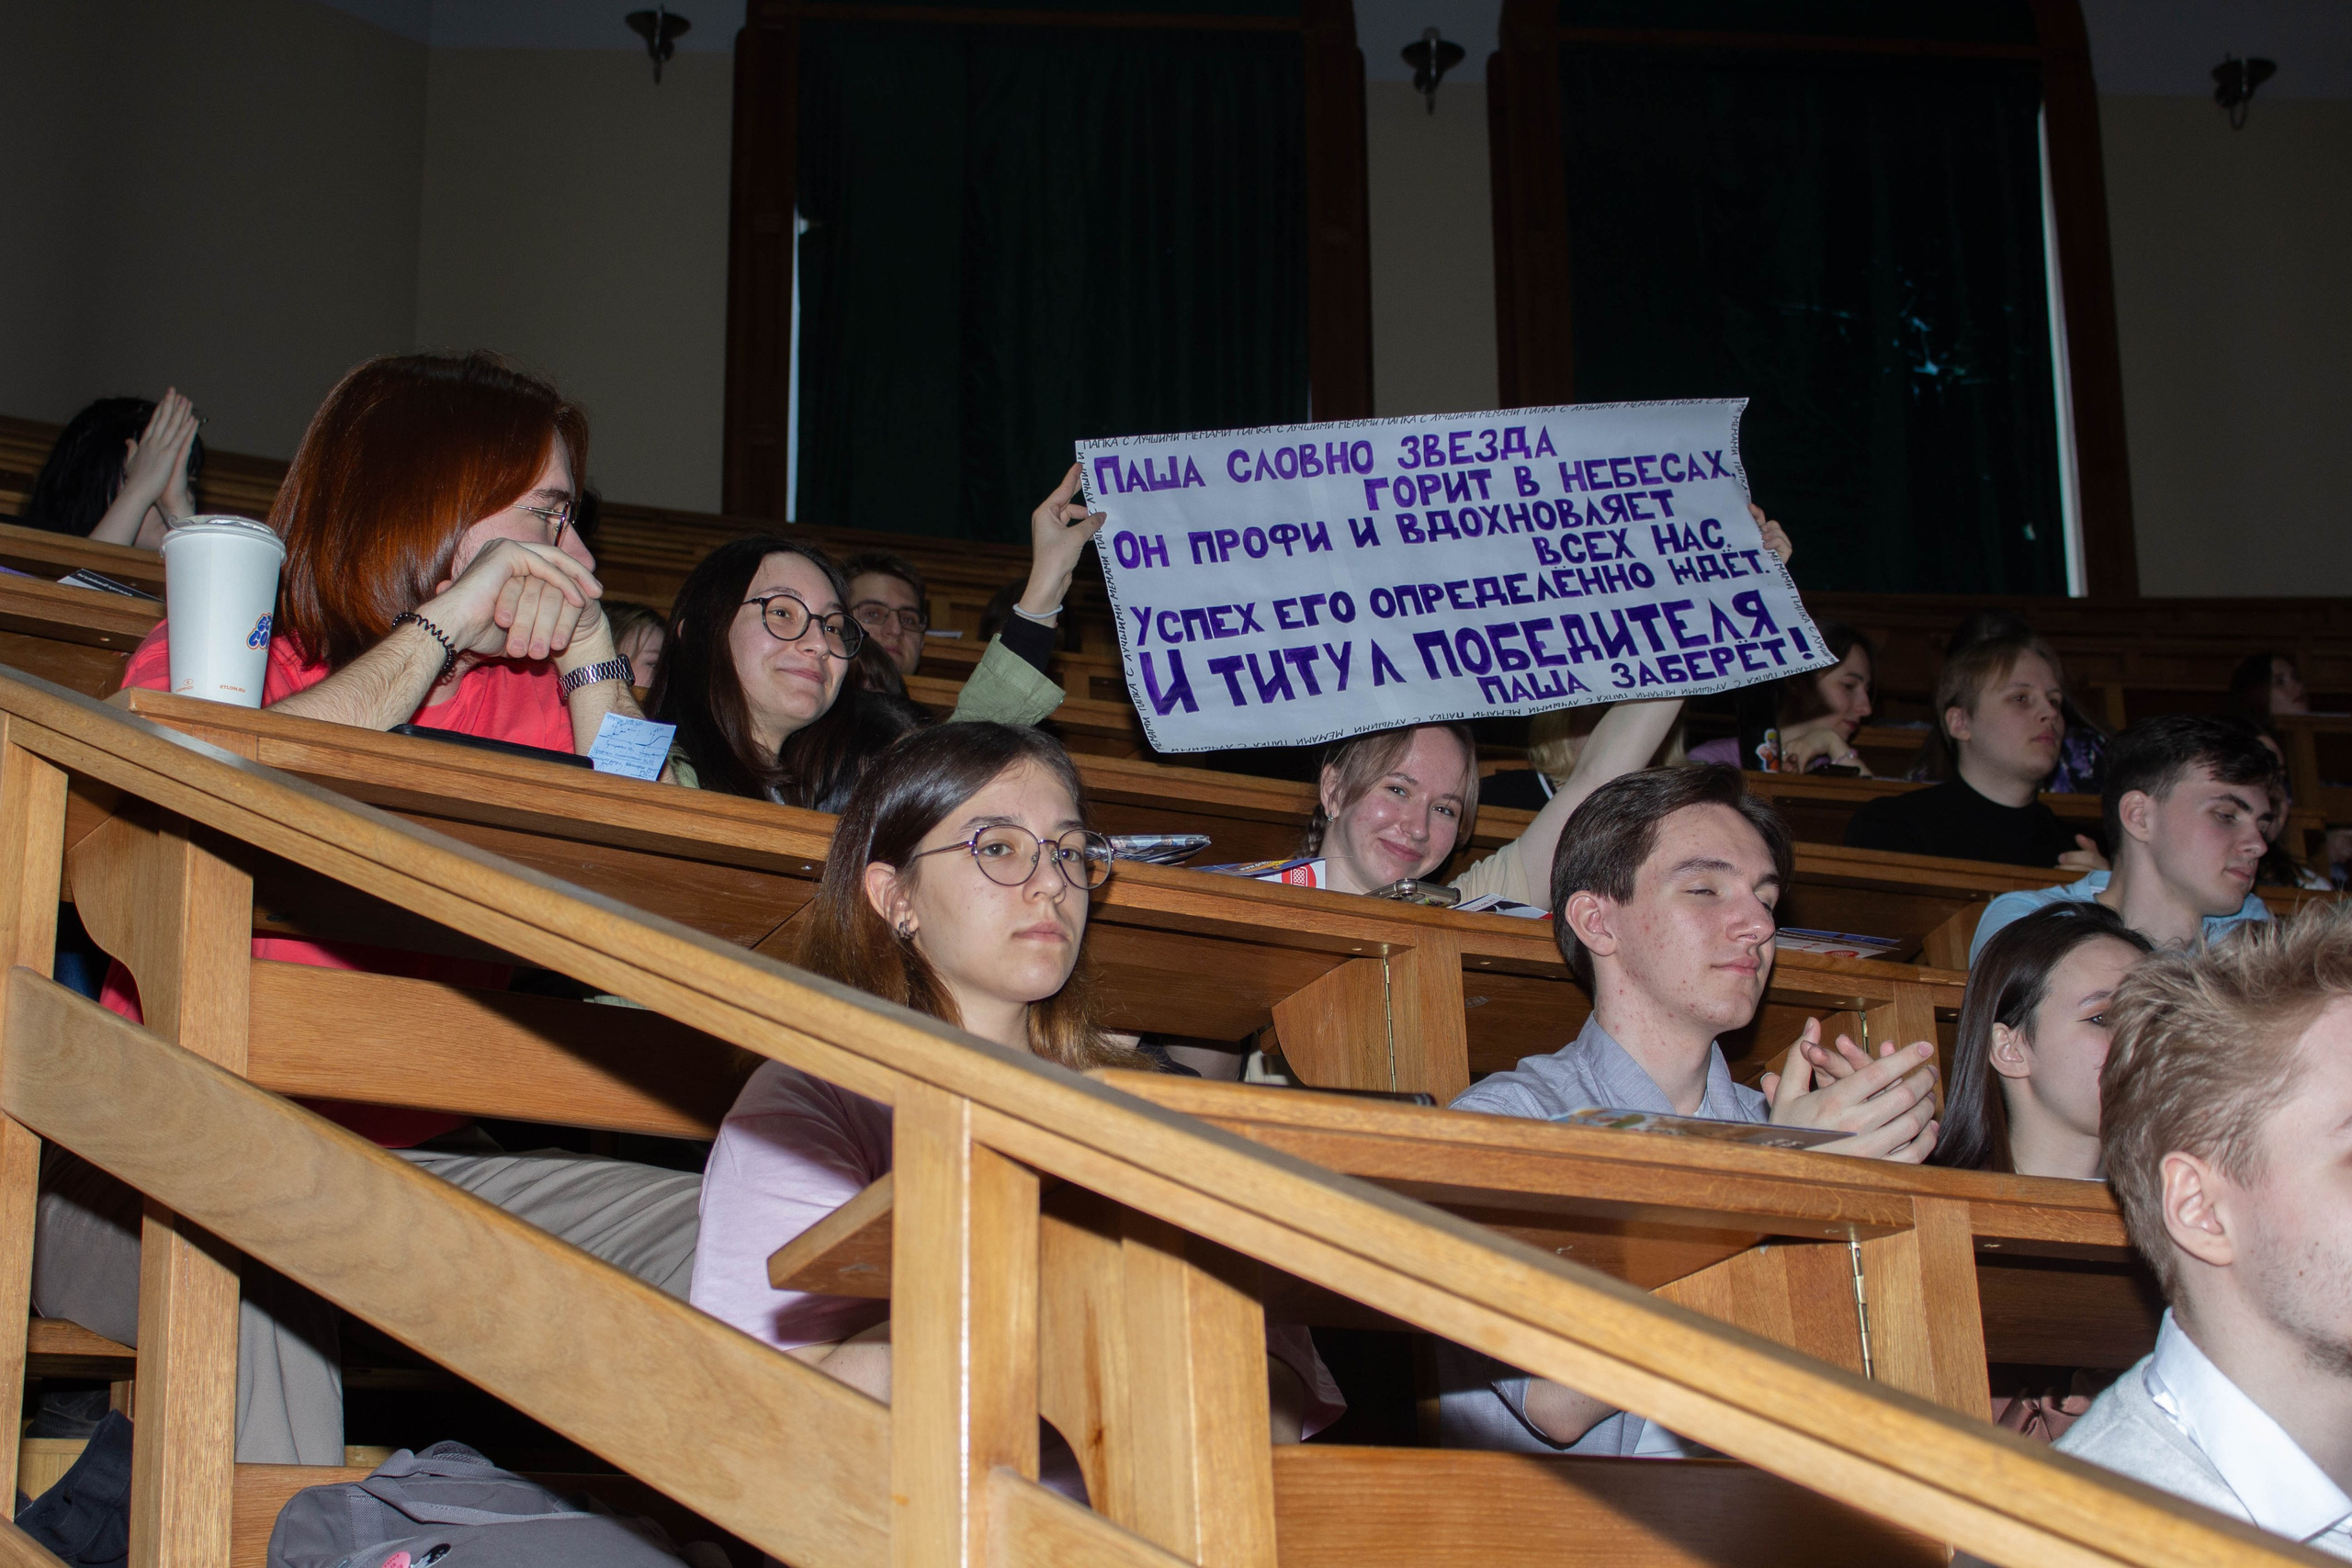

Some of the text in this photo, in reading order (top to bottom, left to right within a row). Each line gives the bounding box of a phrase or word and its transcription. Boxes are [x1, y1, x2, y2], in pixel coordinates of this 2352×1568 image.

[1083, 438, 1119, 450] ПАПКА
[1123, 437, 1129, 446] С
[1134, 433, 1181, 446] ЛУЧШИМИ
[1185, 429, 1232, 441] МЕМАМИ
[1237, 425, 1272, 436] ПАПКА
[1277, 424, 1284, 433] С
[1287, 422, 1335, 433] ЛУЧШИМИ
[1339, 418, 1378, 430] МЕМАМИ
[1381, 415, 1418, 426] ПАПКА
[1420, 414, 1427, 423] С
[1430, 411, 1477, 422] ЛУЧШИМИ
[1479, 408, 1521, 419] МЕМАМИ
[1523, 405, 1556, 415] ПАПКА
[1560, 404, 1567, 413] С
[1571, 401, 1621, 412] ЛУЧШИМИ
[1094, 425, 1557, 495] ПАША СЛОВНО ЗВЕЗДА
[1363, 449, 1736, 511] ГОРИТ В НЕБЕСАХ,
[1094, 528, 1107, 549] ПАП
[1113, 489, 1675, 570] ОН ПРОФИ И ВДОХНОВЛЯЕТ
[1532, 527, 1637, 566] ВСЕХ
[1650, 518, 1733, 556] НАС.
[1103, 556, 1119, 601] МЕМАМИ
[1767, 551, 1795, 591] МЕМАМИ
[1791, 595, 1811, 625] ПАПКА
[1129, 548, 1771, 647] УСПЕХ ЕГО ОПРЕДЕЛЁННО ЖДЁТ.
[1114, 603, 1132, 662] ЛУЧШИМИ
[1138, 649, 1200, 716] И
[1412, 589, 1781, 681] ПОБЕДИТЕЛЯ
[1126, 667, 1135, 678] С
[1476, 626, 1815, 705] ПАША ЗАБЕРЁТ!
[1681, 682, 1727, 695] ЛУЧШИМИ
[1733, 680, 1741, 689] С
[1747, 672, 1779, 684] ПАПКА
[220, 684, 246, 694] ETLON.RU
[1128, 682, 1148, 712] ПАПКА
[1597, 693, 1629, 703] ПАПКА
[1635, 688, 1676, 698] МЕМАМИ
[1429, 711, 1464, 721] ПАПКА
[1472, 708, 1521, 718] МЕМАМИ
[1528, 698, 1579, 714] ЛУЧШИМИ
[1353, 718, 1407, 734] ЛУЧШИМИ
[1296, 728, 1343, 746] МЕМАМИ
